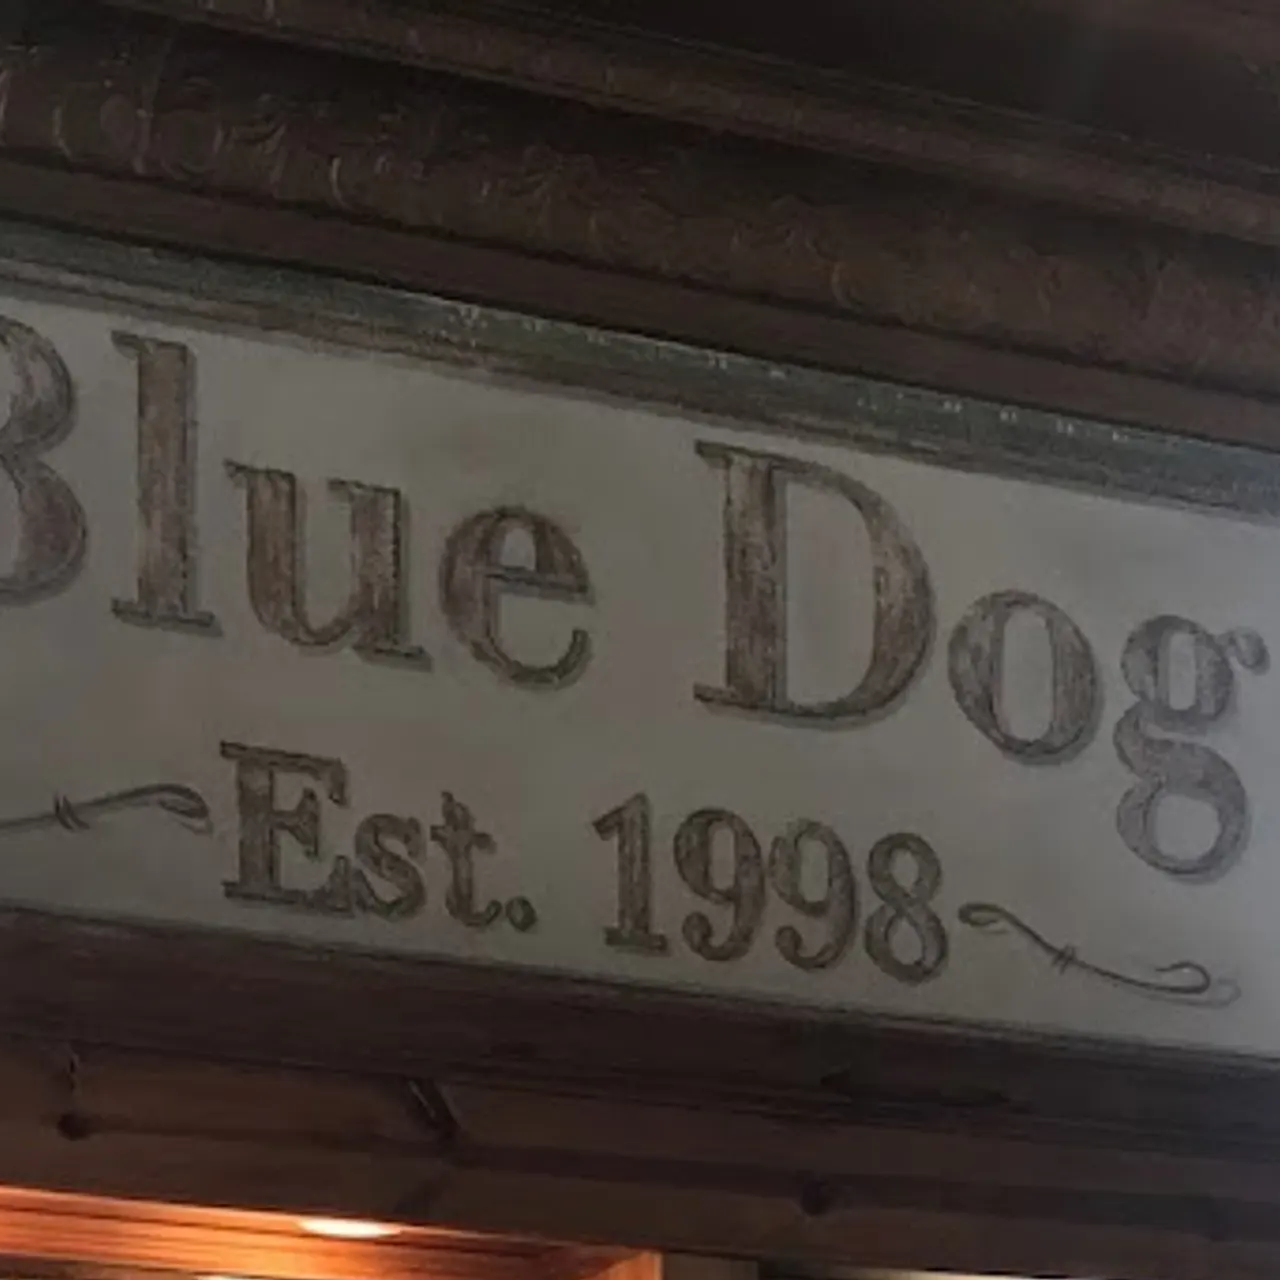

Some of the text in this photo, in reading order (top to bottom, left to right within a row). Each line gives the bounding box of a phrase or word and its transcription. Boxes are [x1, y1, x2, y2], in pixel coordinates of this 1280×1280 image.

[694, 438, 1270, 884] Dog
[220, 741, 950, 985] Est. 1998
